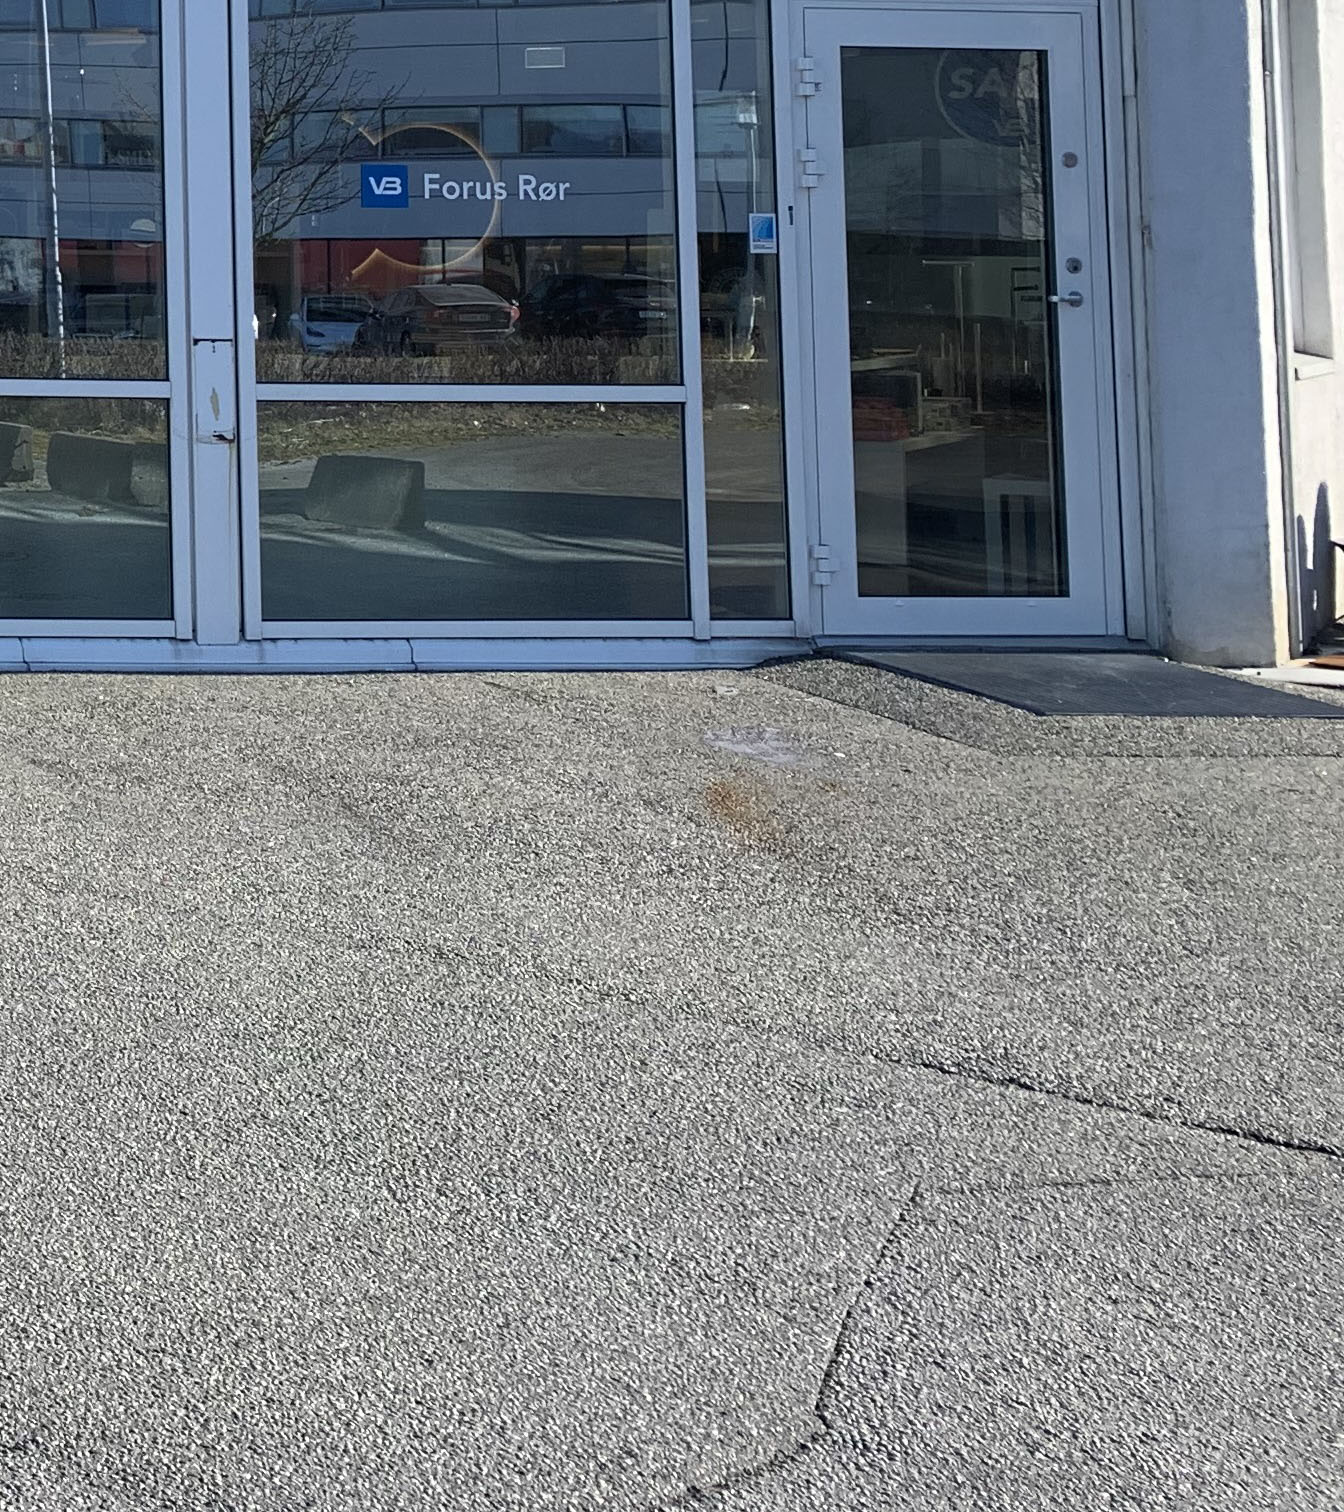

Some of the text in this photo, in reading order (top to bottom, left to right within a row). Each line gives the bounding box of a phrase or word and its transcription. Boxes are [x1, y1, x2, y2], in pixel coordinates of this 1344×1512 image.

[368, 176, 402, 195] VB
[423, 173, 571, 201] Forus Rør
